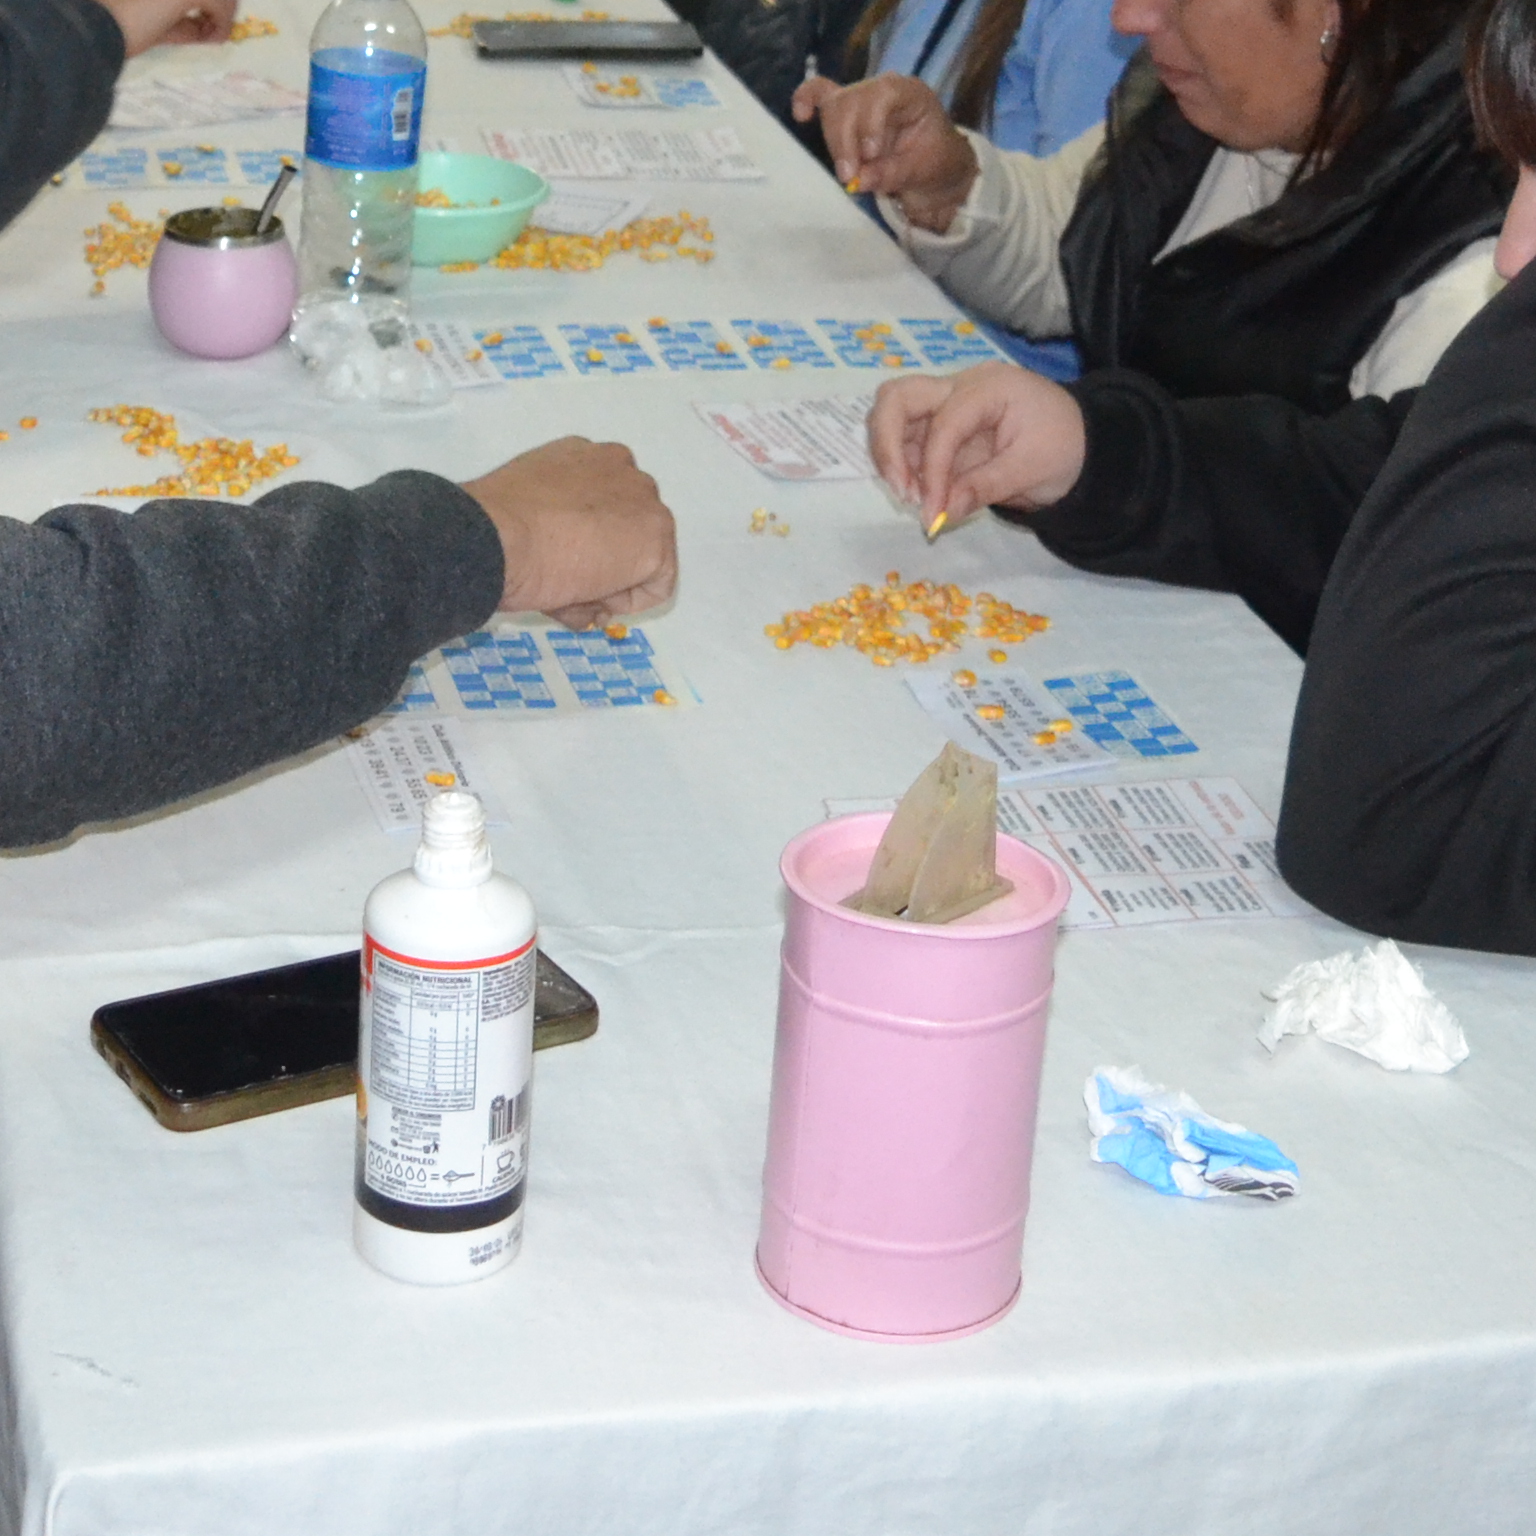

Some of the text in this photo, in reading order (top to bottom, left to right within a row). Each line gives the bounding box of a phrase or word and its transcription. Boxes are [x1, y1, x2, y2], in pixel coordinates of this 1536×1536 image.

[378, 961, 473, 984] INFORMACIÓN NUTRICIONAL
[388, 1150, 399, 1160] DE
